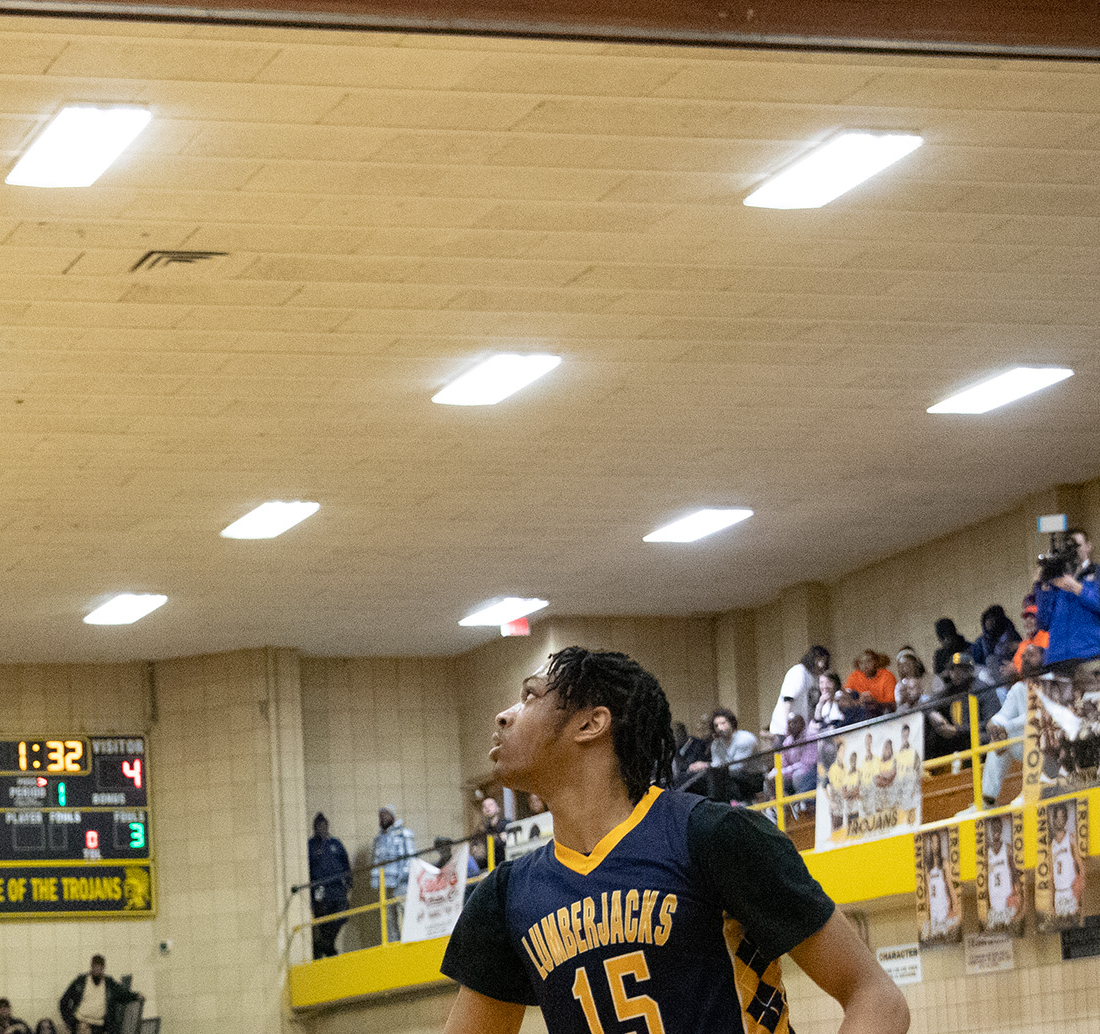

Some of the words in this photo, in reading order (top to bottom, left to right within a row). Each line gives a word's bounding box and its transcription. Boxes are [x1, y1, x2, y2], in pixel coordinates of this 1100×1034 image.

[18, 740, 83, 772] 1:32
[122, 758, 142, 788] 4
[58, 782, 66, 806] 1
[85, 830, 98, 849] 0
[129, 822, 145, 848] 3
[7, 878, 26, 902] OF
[31, 878, 58, 901] THE
[61, 877, 122, 901] TROJANS
[521, 889, 678, 980] LUMBERJACKS
